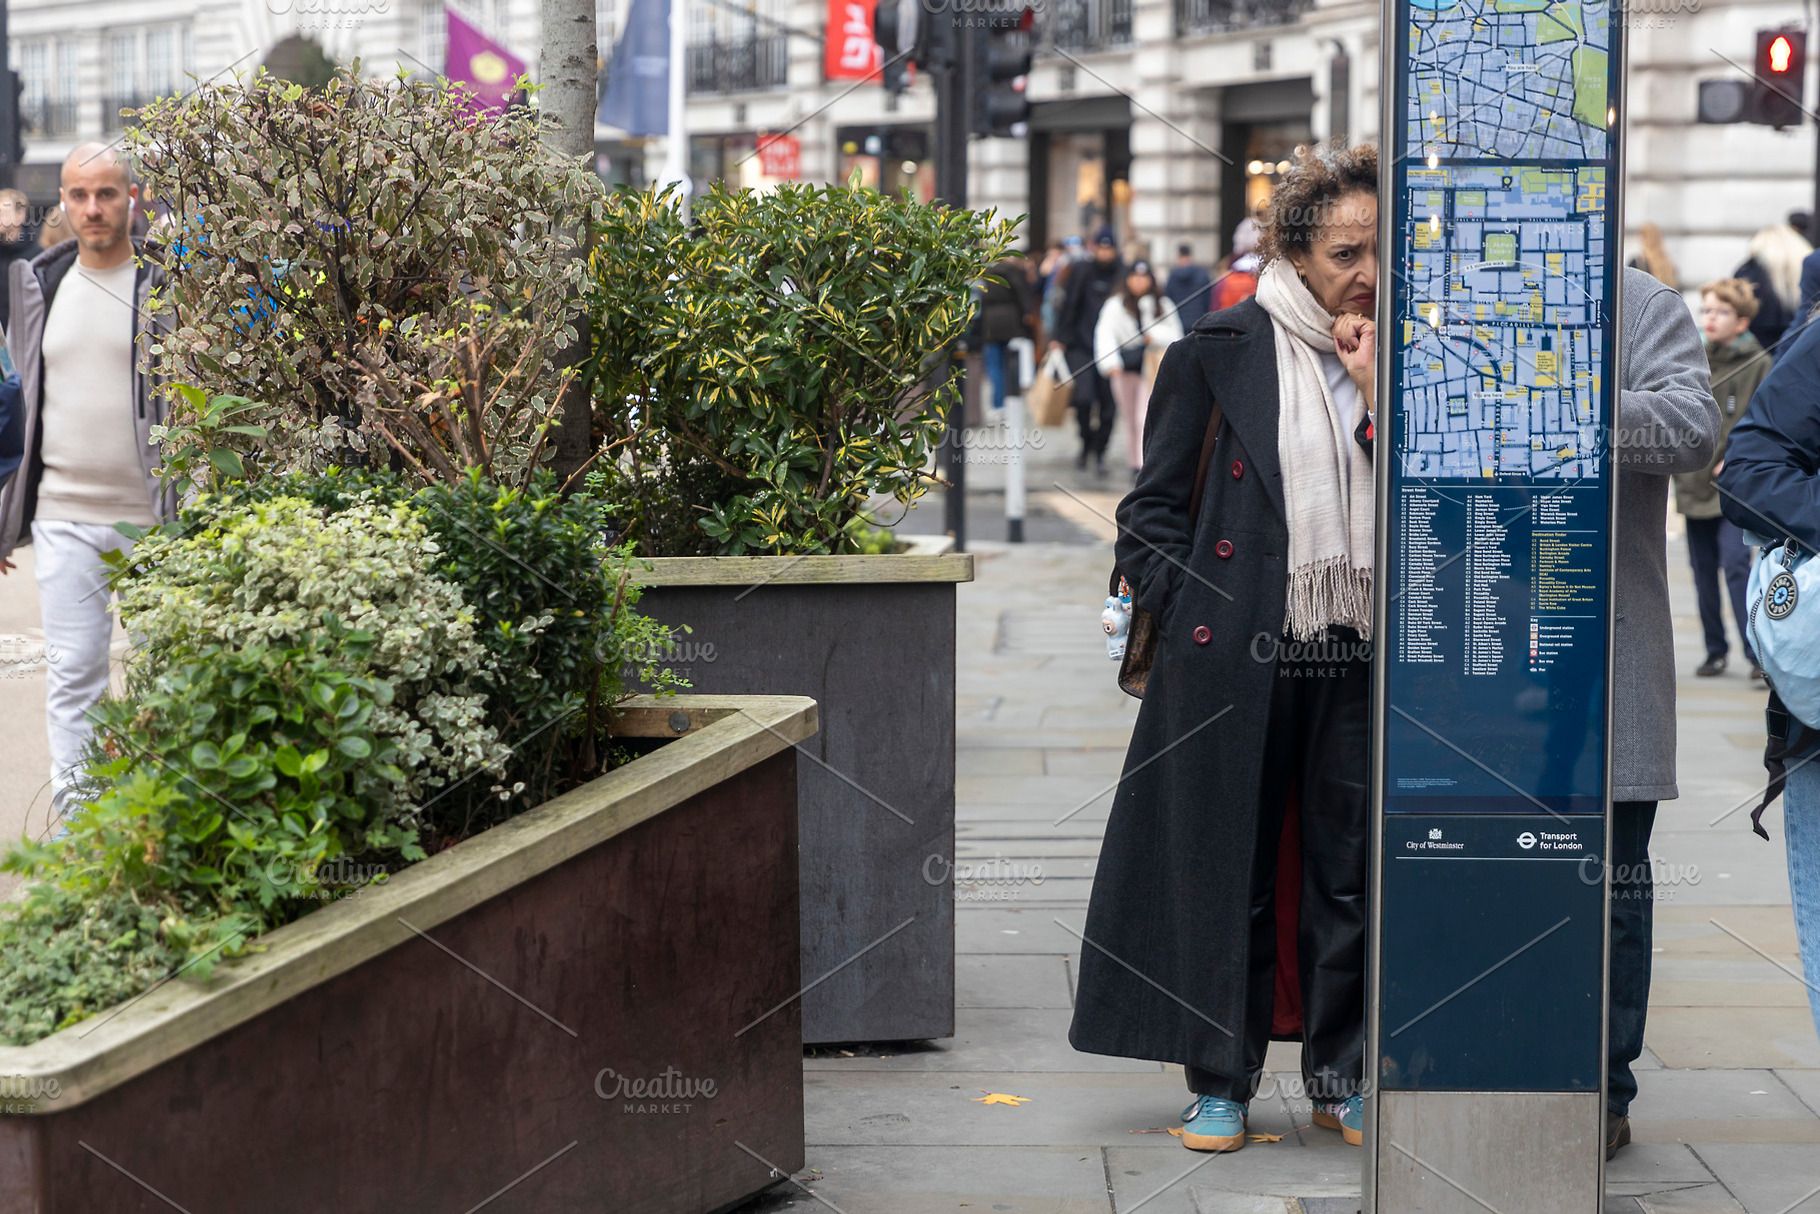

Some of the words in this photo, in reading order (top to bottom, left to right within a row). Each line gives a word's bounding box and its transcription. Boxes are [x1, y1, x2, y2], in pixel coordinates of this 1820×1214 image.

[1406, 391, 1447, 399] SOHO
[1540, 832, 1577, 841] Transport
[1406, 841, 1418, 850] City
[1428, 842, 1464, 850] Westminster
